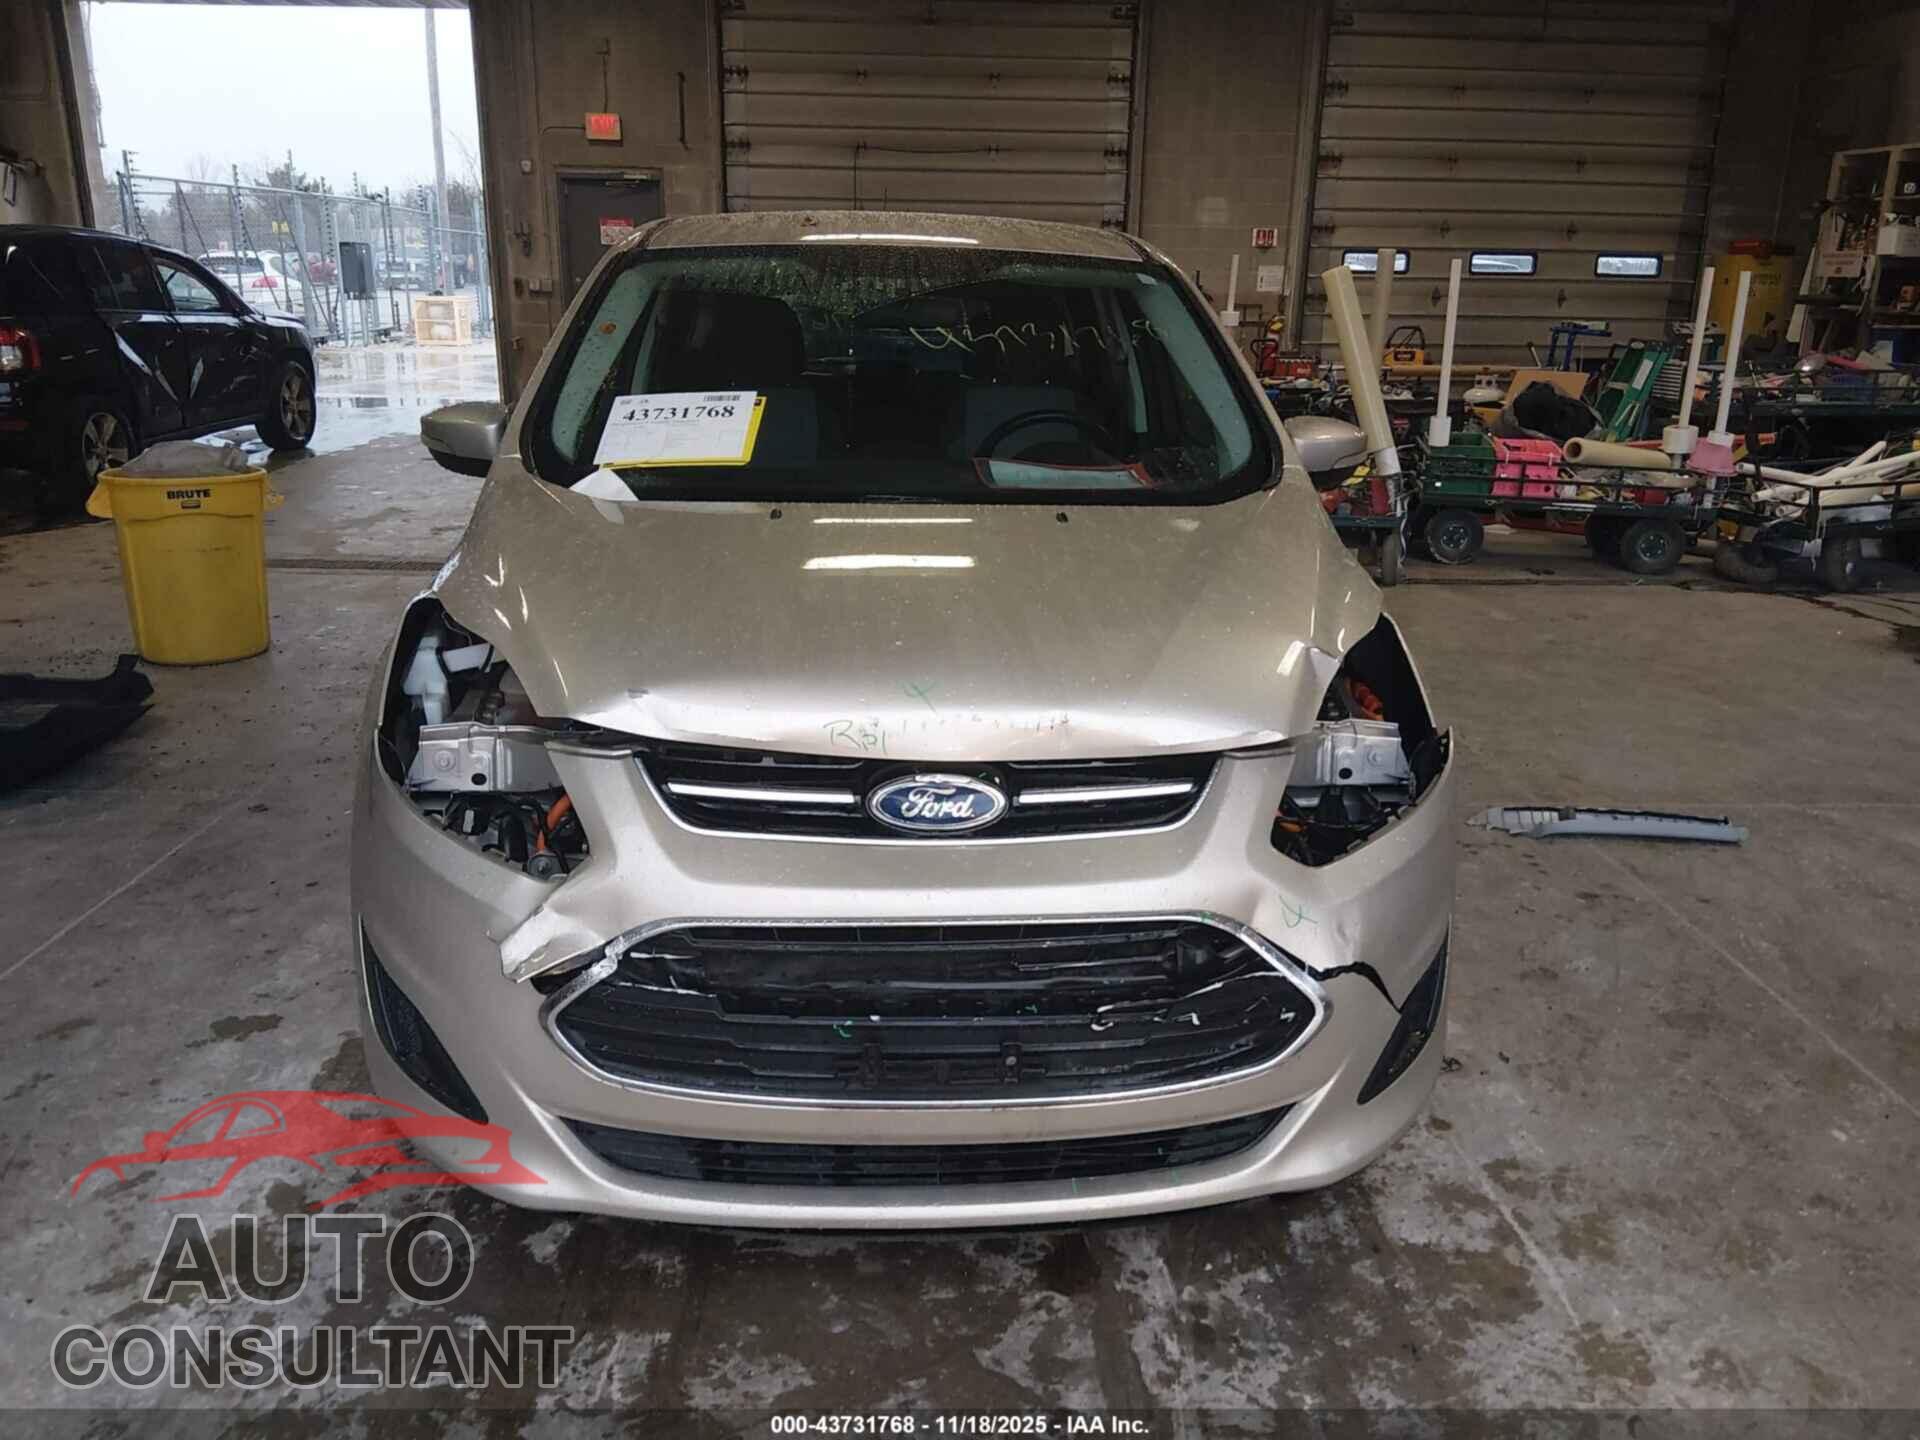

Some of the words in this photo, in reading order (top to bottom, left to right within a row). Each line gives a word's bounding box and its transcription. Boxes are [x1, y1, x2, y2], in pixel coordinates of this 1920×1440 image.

[623, 405, 736, 422] 43731768
[166, 488, 212, 499] BRUTE
[901, 787, 975, 818] Ford
